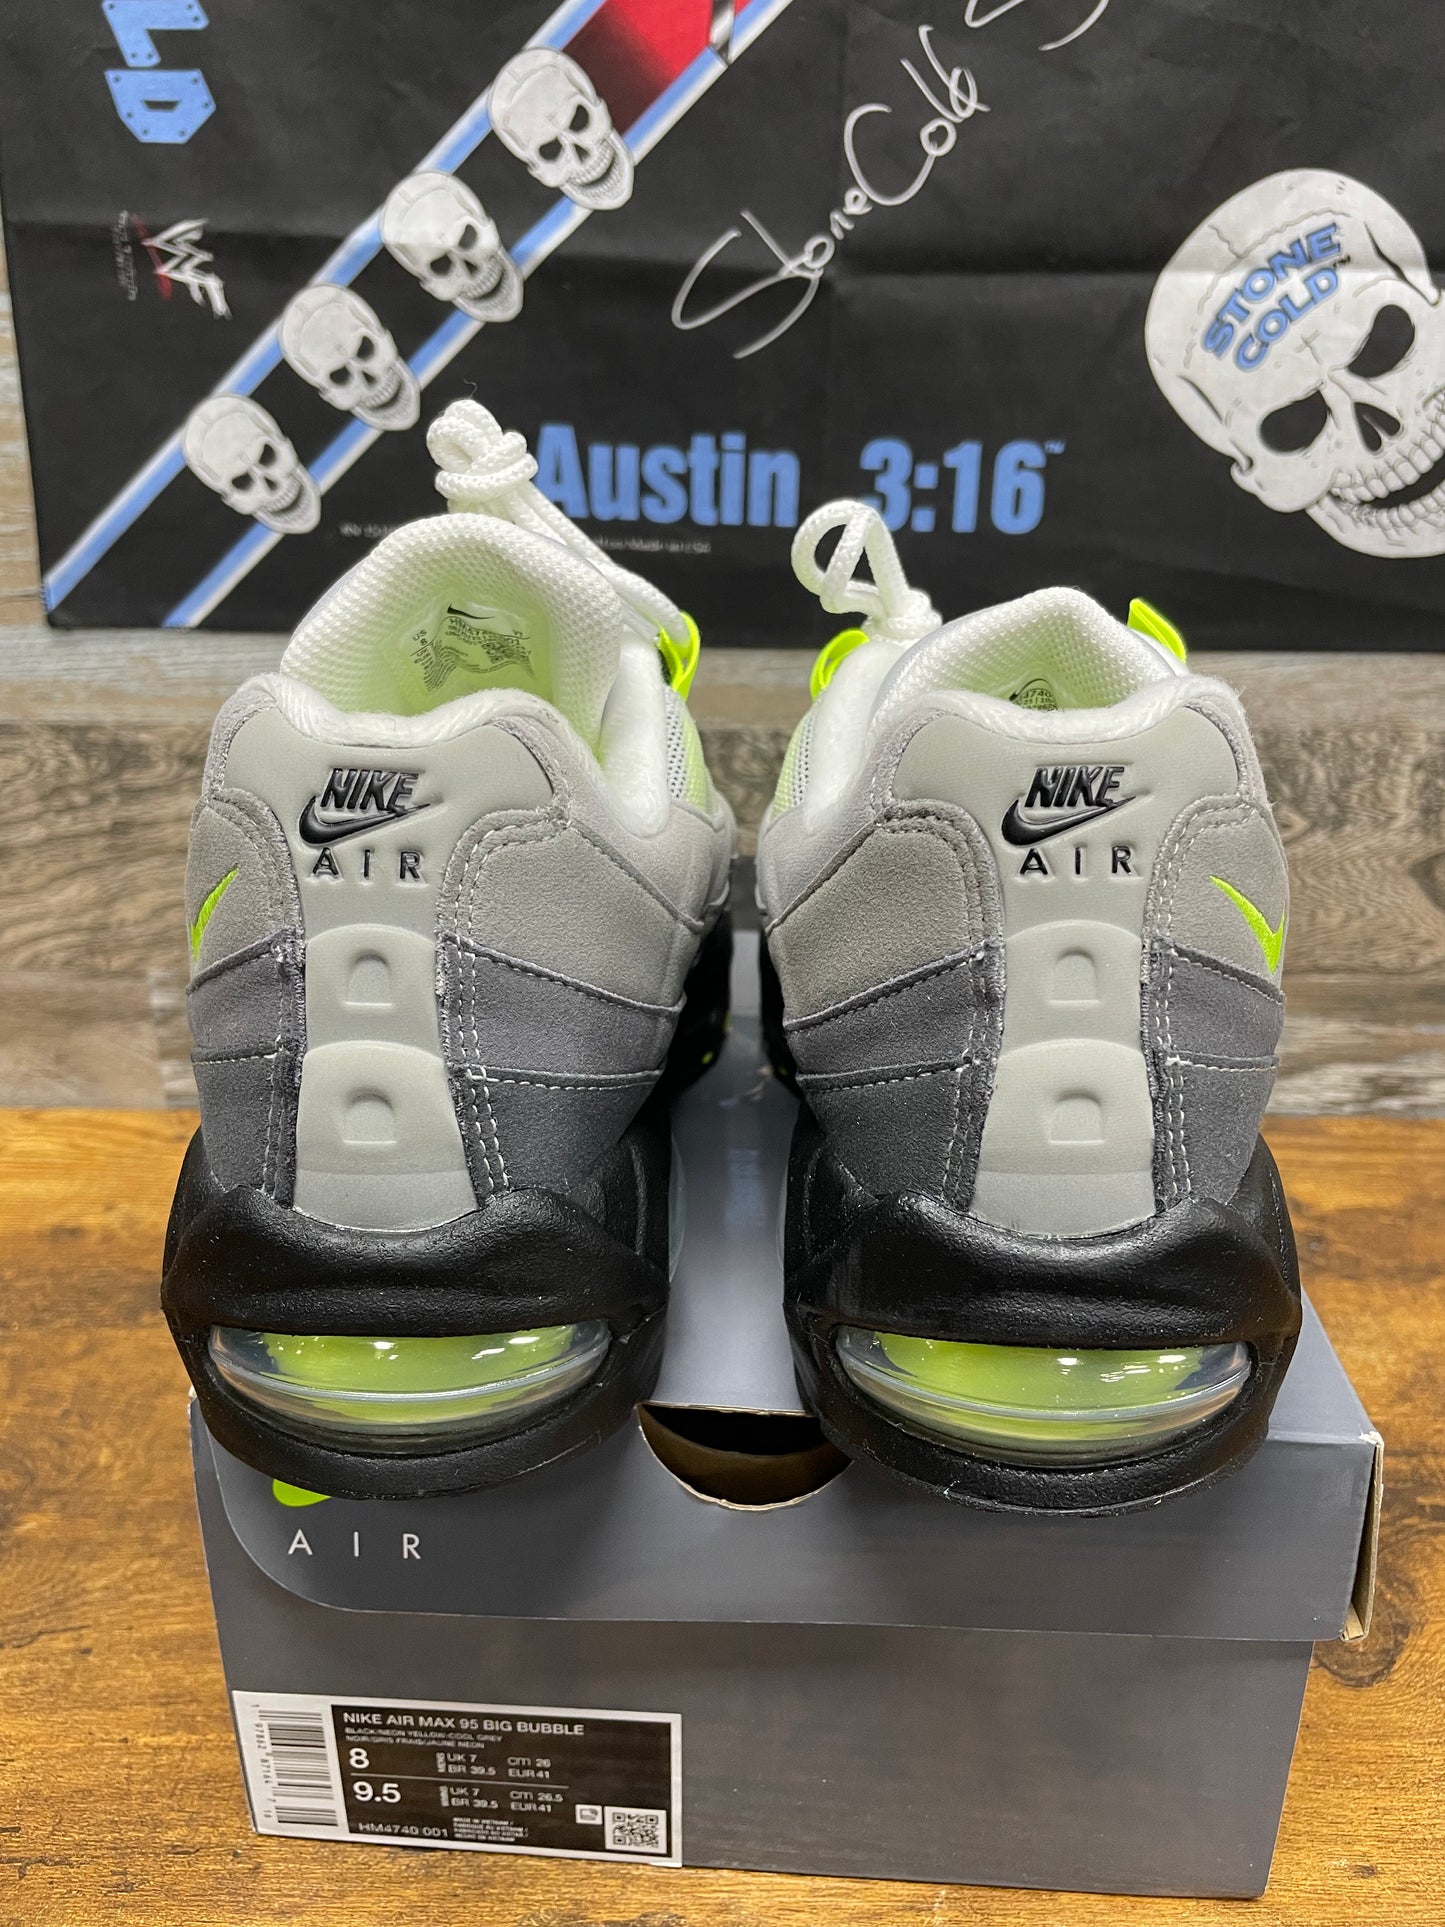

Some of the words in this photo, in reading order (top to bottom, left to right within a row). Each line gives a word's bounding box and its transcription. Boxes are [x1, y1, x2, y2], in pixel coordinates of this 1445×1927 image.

[1203, 222, 1341, 358] STONE
[536, 422, 800, 528] Austin
[320, 768, 419, 814] NIKE
[1024, 766, 1125, 808] NIKE
[312, 847, 420, 879] AIR
[1019, 846, 1132, 875] AIR
[287, 1528, 422, 1560] AIR
[343, 1712, 383, 1725] NIKE
[386, 1714, 415, 1727] AIR
[418, 1716, 456, 1729] MAX
[459, 1718, 479, 1730] 95
[482, 1719, 512, 1732] BIG
[516, 1721, 585, 1736] BUBBLE
[349, 1747, 370, 1769] 8
[446, 1752, 466, 1762] UK
[469, 1753, 478, 1763] 7
[447, 1764, 467, 1774] BR
[352, 1781, 402, 1803] 9.5
[449, 1786, 470, 1796] UK
[472, 1787, 480, 1797] 7
